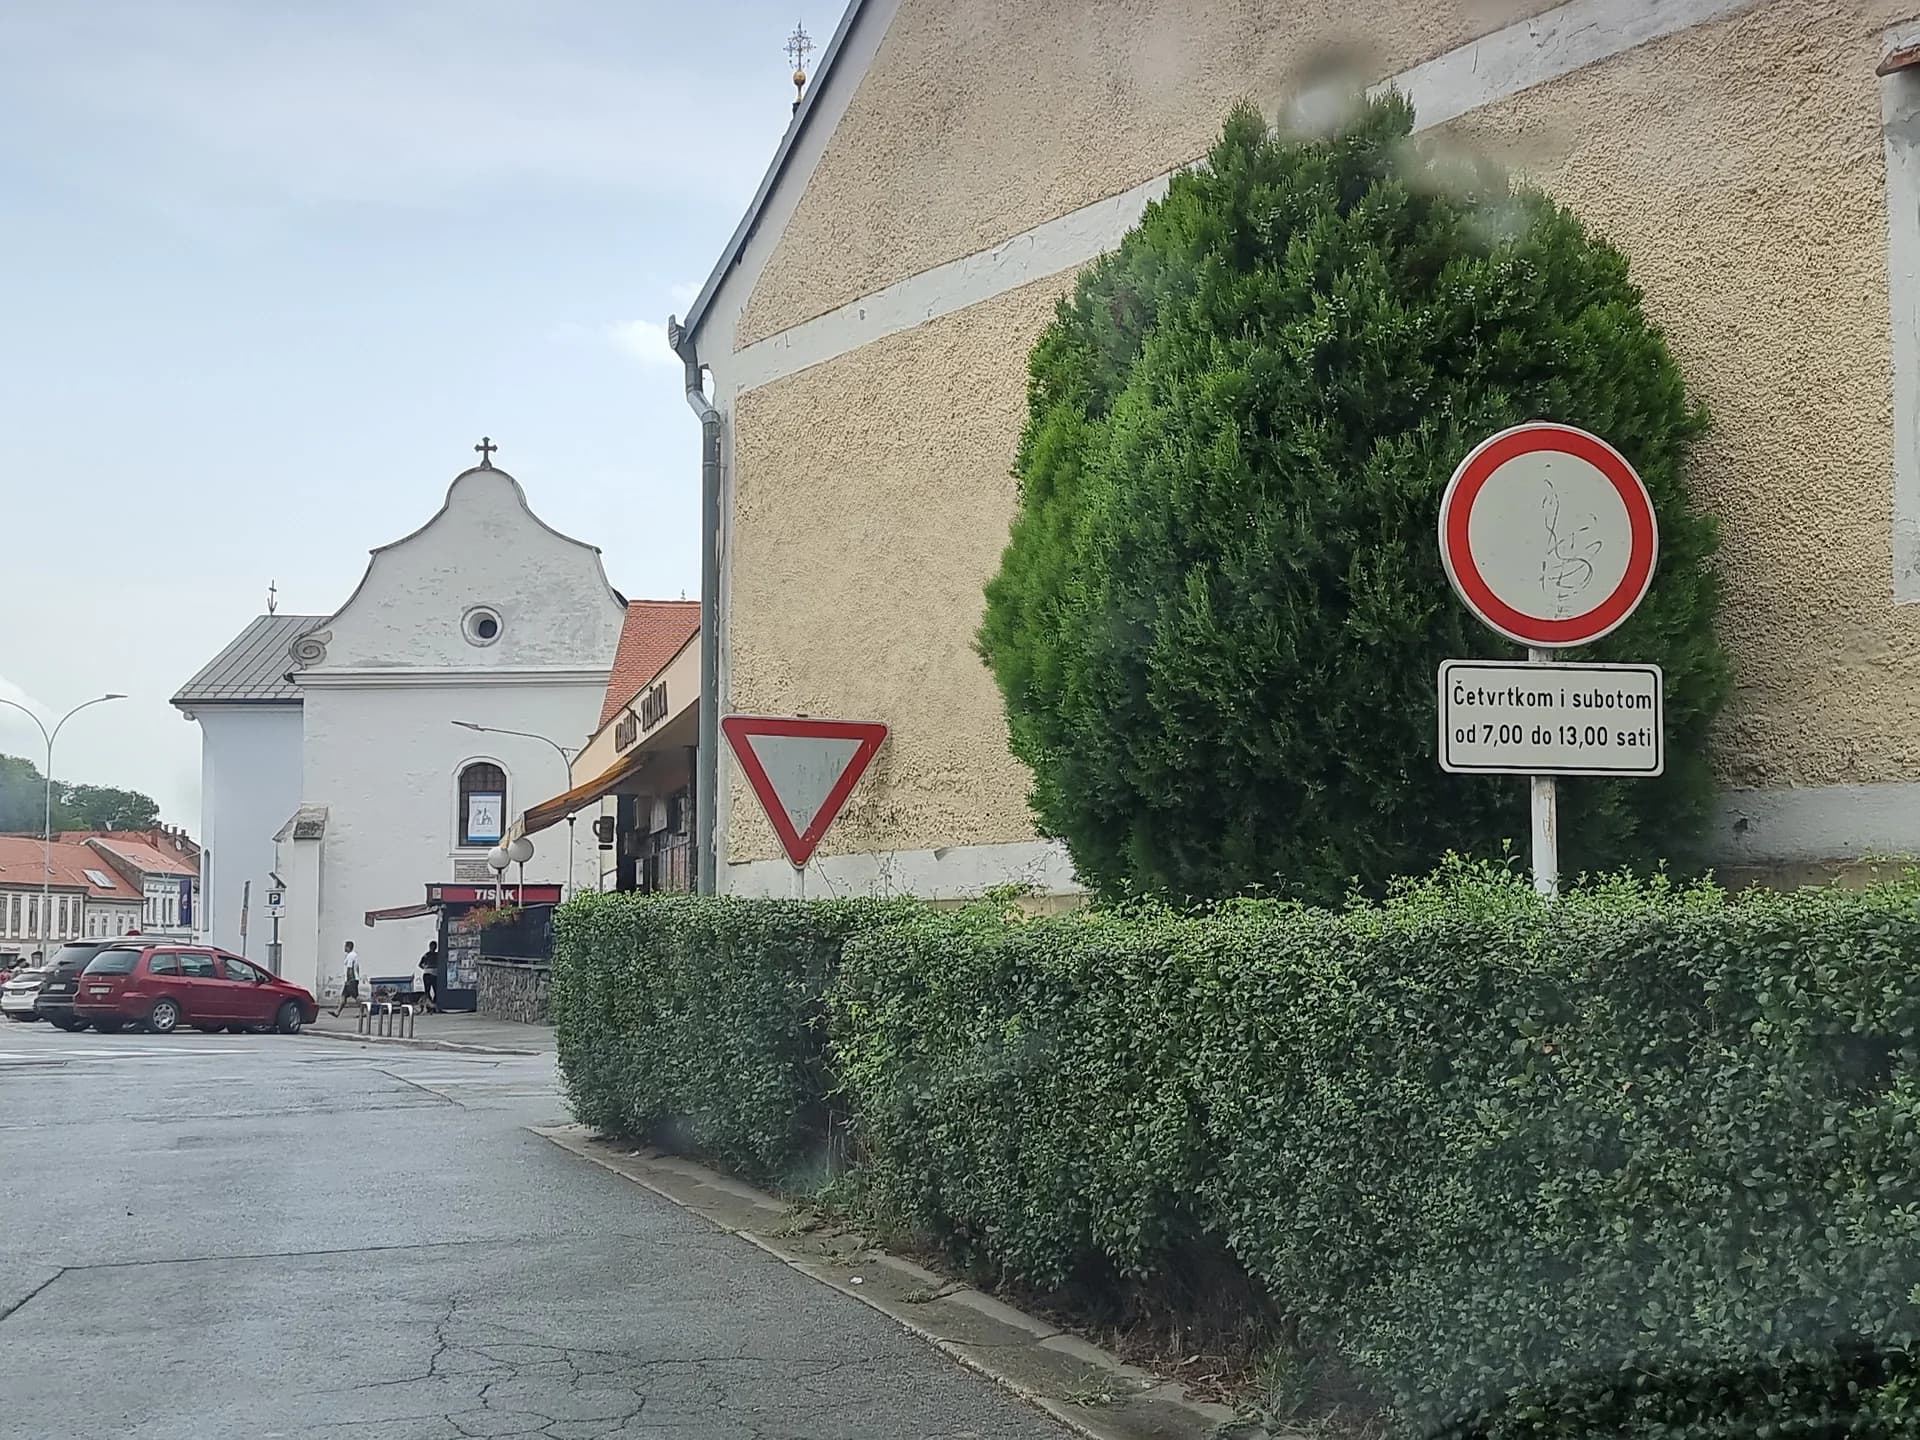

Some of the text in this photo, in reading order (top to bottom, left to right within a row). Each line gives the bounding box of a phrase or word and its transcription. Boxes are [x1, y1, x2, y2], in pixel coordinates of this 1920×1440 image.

[1453, 680, 1652, 709] Četvrtkom i subotom
[1455, 724, 1652, 749] od 7,00 do 13,00 sati
